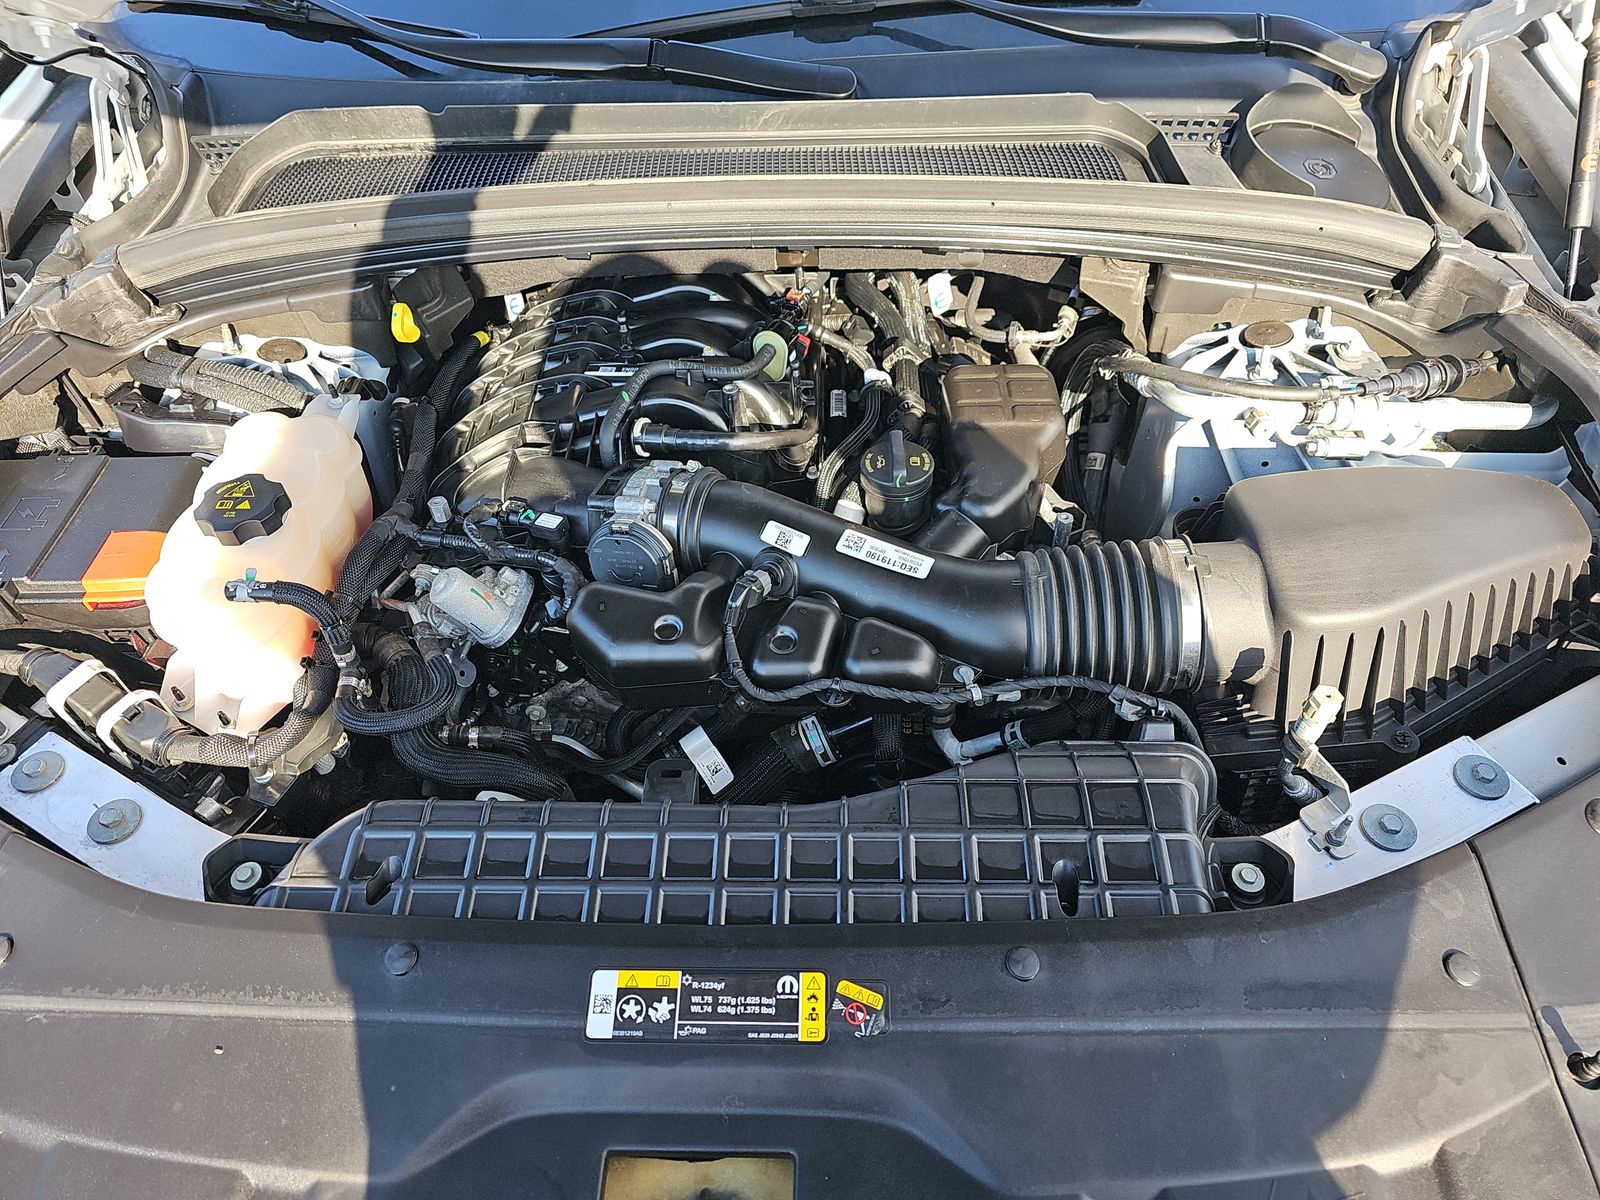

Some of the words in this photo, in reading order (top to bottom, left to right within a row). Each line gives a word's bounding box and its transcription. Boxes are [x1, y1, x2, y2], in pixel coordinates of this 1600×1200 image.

[865, 550, 920, 574] SEQ:119190
[692, 981, 726, 991] R-1234yf
[691, 995, 713, 1004] WL75
[718, 996, 736, 1005] 737g
[737, 996, 760, 1005] (1.625
[761, 996, 776, 1006] lbs)
[690, 1005, 712, 1013] WL74
[717, 1005, 736, 1015] 624g
[737, 1006, 760, 1015] (1.375
[761, 1006, 776, 1015] lbs)
[692, 1026, 707, 1035] PAG
